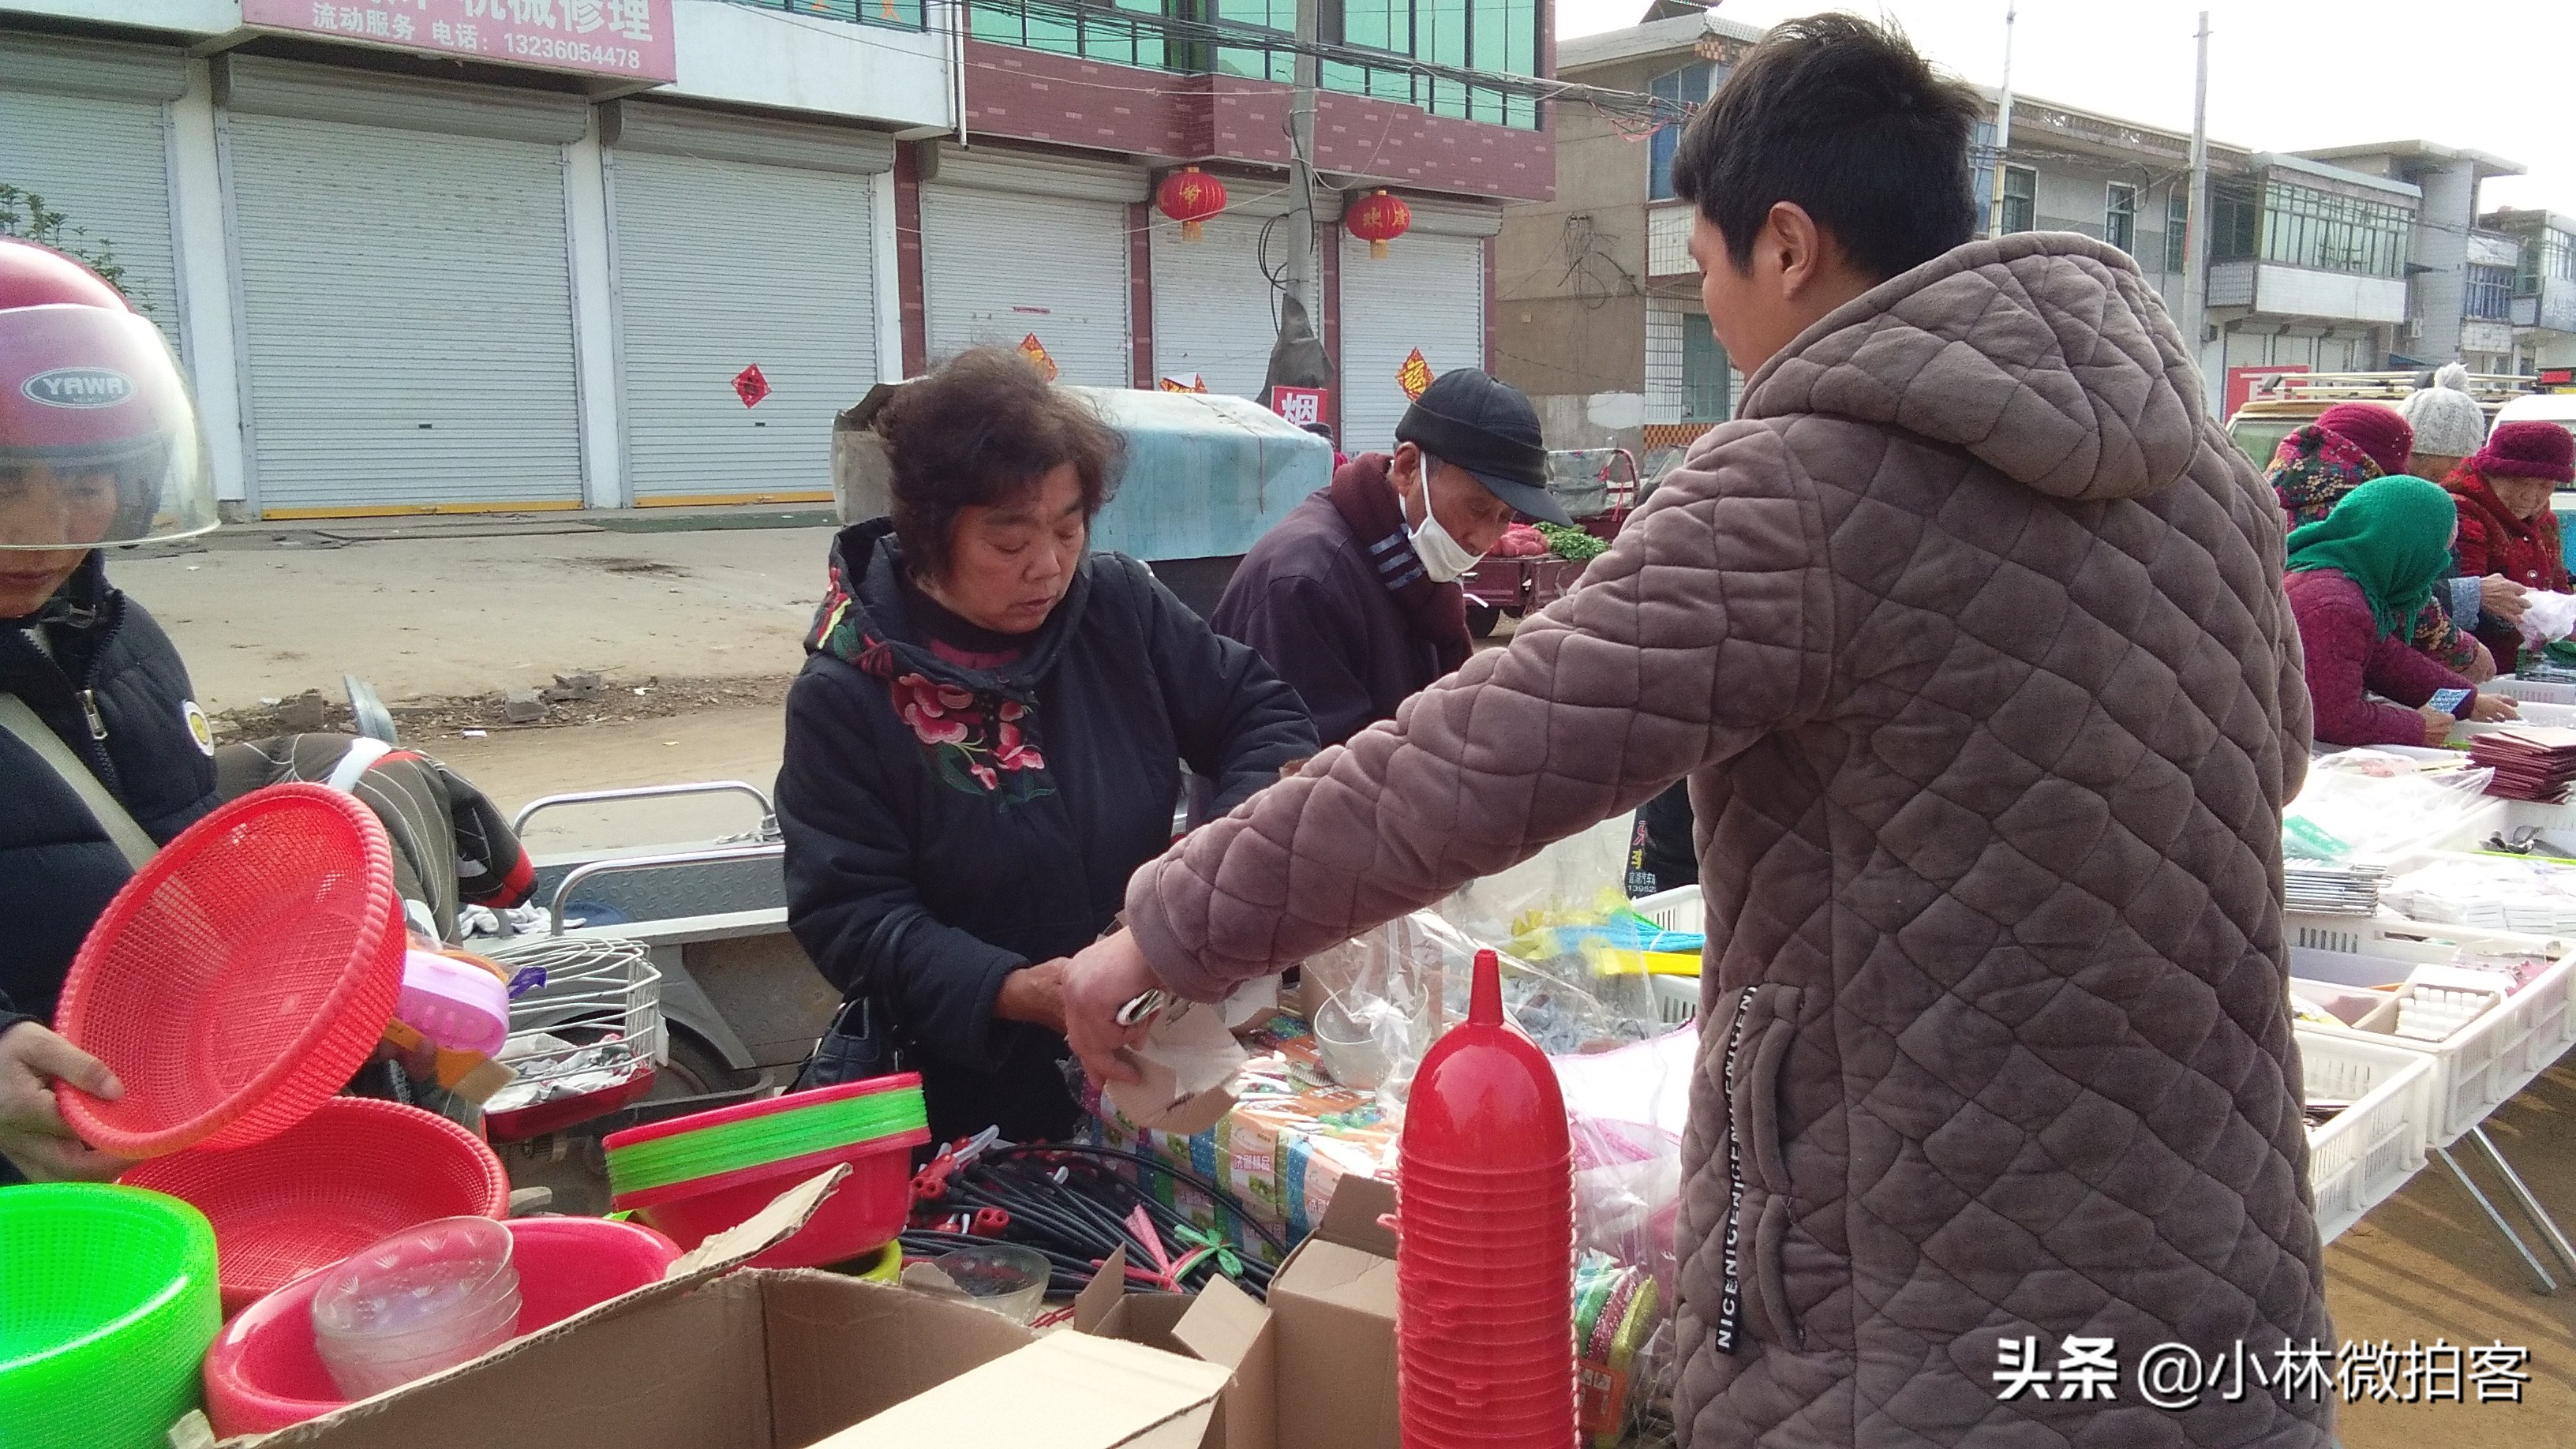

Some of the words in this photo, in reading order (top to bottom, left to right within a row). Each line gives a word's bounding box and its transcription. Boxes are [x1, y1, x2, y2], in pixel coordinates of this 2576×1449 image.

[313, 2, 416, 40] 流动服务
[504, 33, 640, 69] 13236054478
[1282, 393, 1318, 426] 烟
